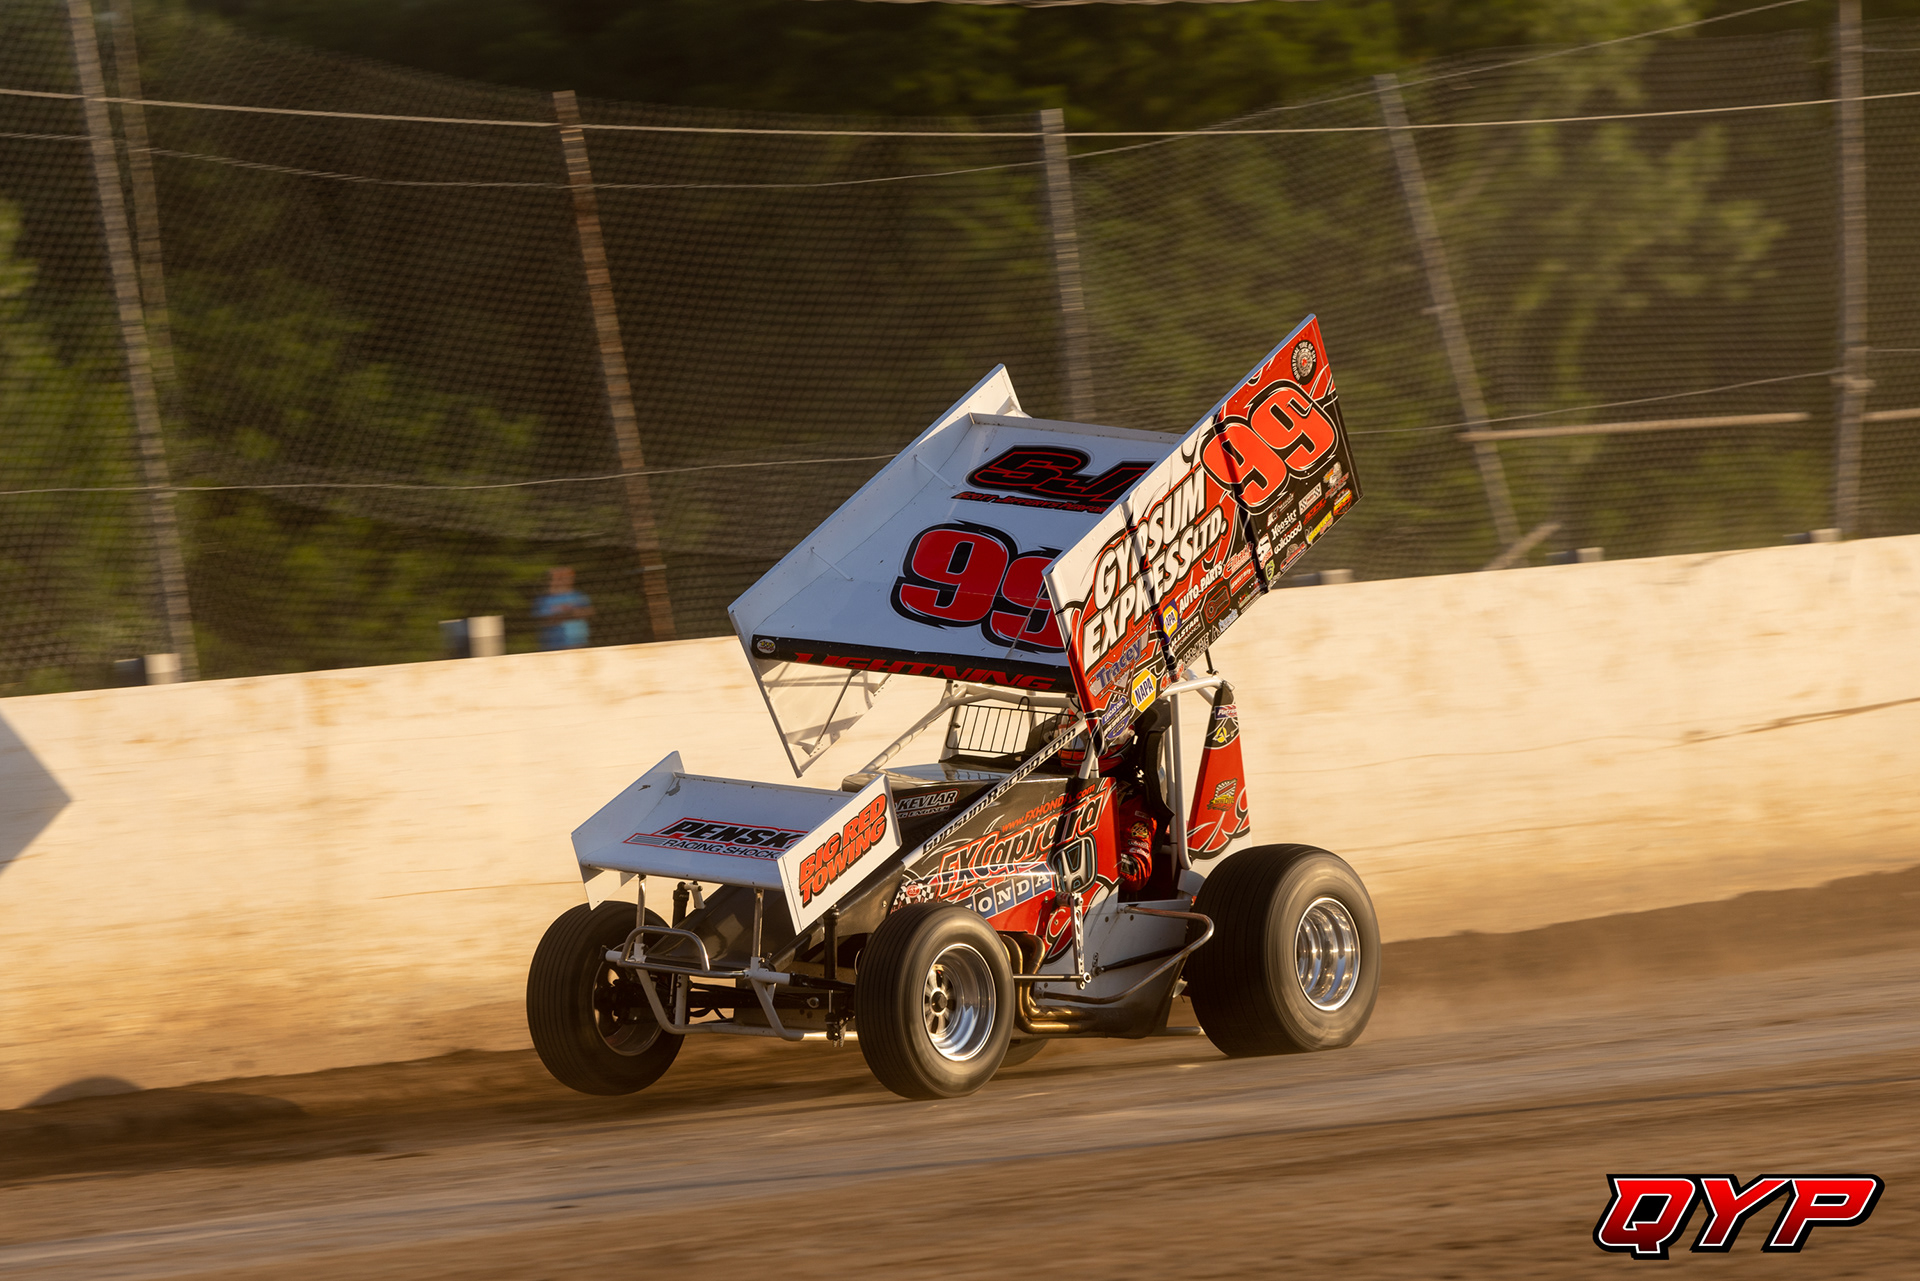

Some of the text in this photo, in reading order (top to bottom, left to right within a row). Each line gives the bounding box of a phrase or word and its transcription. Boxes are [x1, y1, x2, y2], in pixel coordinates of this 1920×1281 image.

[1201, 384, 1336, 510] 99
[1094, 469, 1205, 611] GYPSUM
[896, 526, 1068, 651] 99
[1179, 560, 1223, 614] AUTO PARTS
[794, 652, 1057, 690] LIGHTNING
[1096, 639, 1142, 689] Tracey
[1134, 677, 1154, 705] NAPA
[898, 791, 957, 811] KEVLAR
[1002, 784, 1096, 833] www.FXHONDA.com
[660, 821, 807, 850] PENSK
[664, 839, 724, 854] RACING
[799, 794, 887, 880] BIG RED
[800, 816, 887, 908] TOWING
[966, 867, 1051, 914] ONDA
